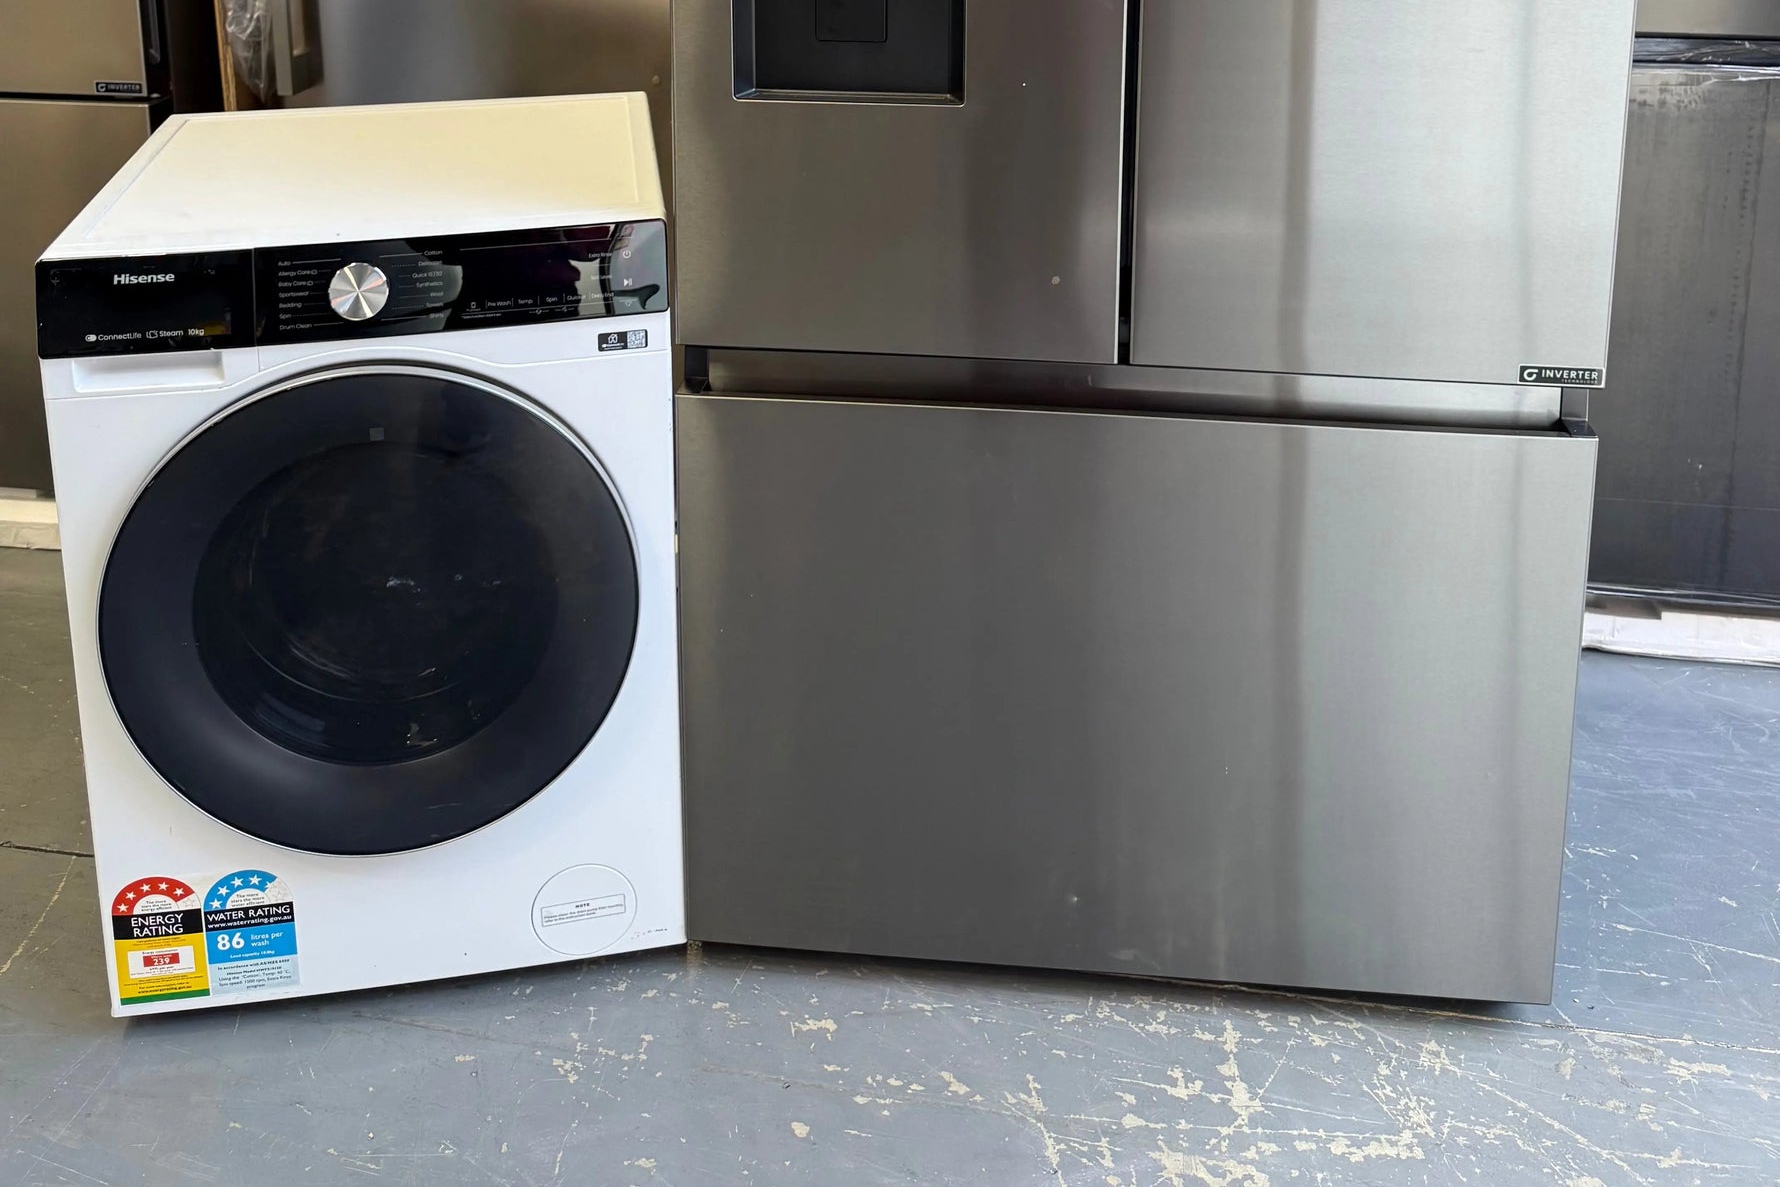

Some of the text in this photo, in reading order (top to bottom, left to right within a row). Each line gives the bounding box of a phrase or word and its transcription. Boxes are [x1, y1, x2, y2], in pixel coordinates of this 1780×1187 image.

[113, 273, 175, 285] Hisense
[98, 332, 142, 341] ConnectLife
[187, 328, 205, 336] 10kg
[1541, 369, 1599, 379] INVERTER
[131, 913, 183, 927] ENERGY
[207, 905, 290, 921] WATER RATING
[208, 915, 292, 929] www.waterrating.gov.au
[133, 924, 184, 938] RATING
[217, 932, 245, 950] 86
[153, 958, 170, 966] 239
